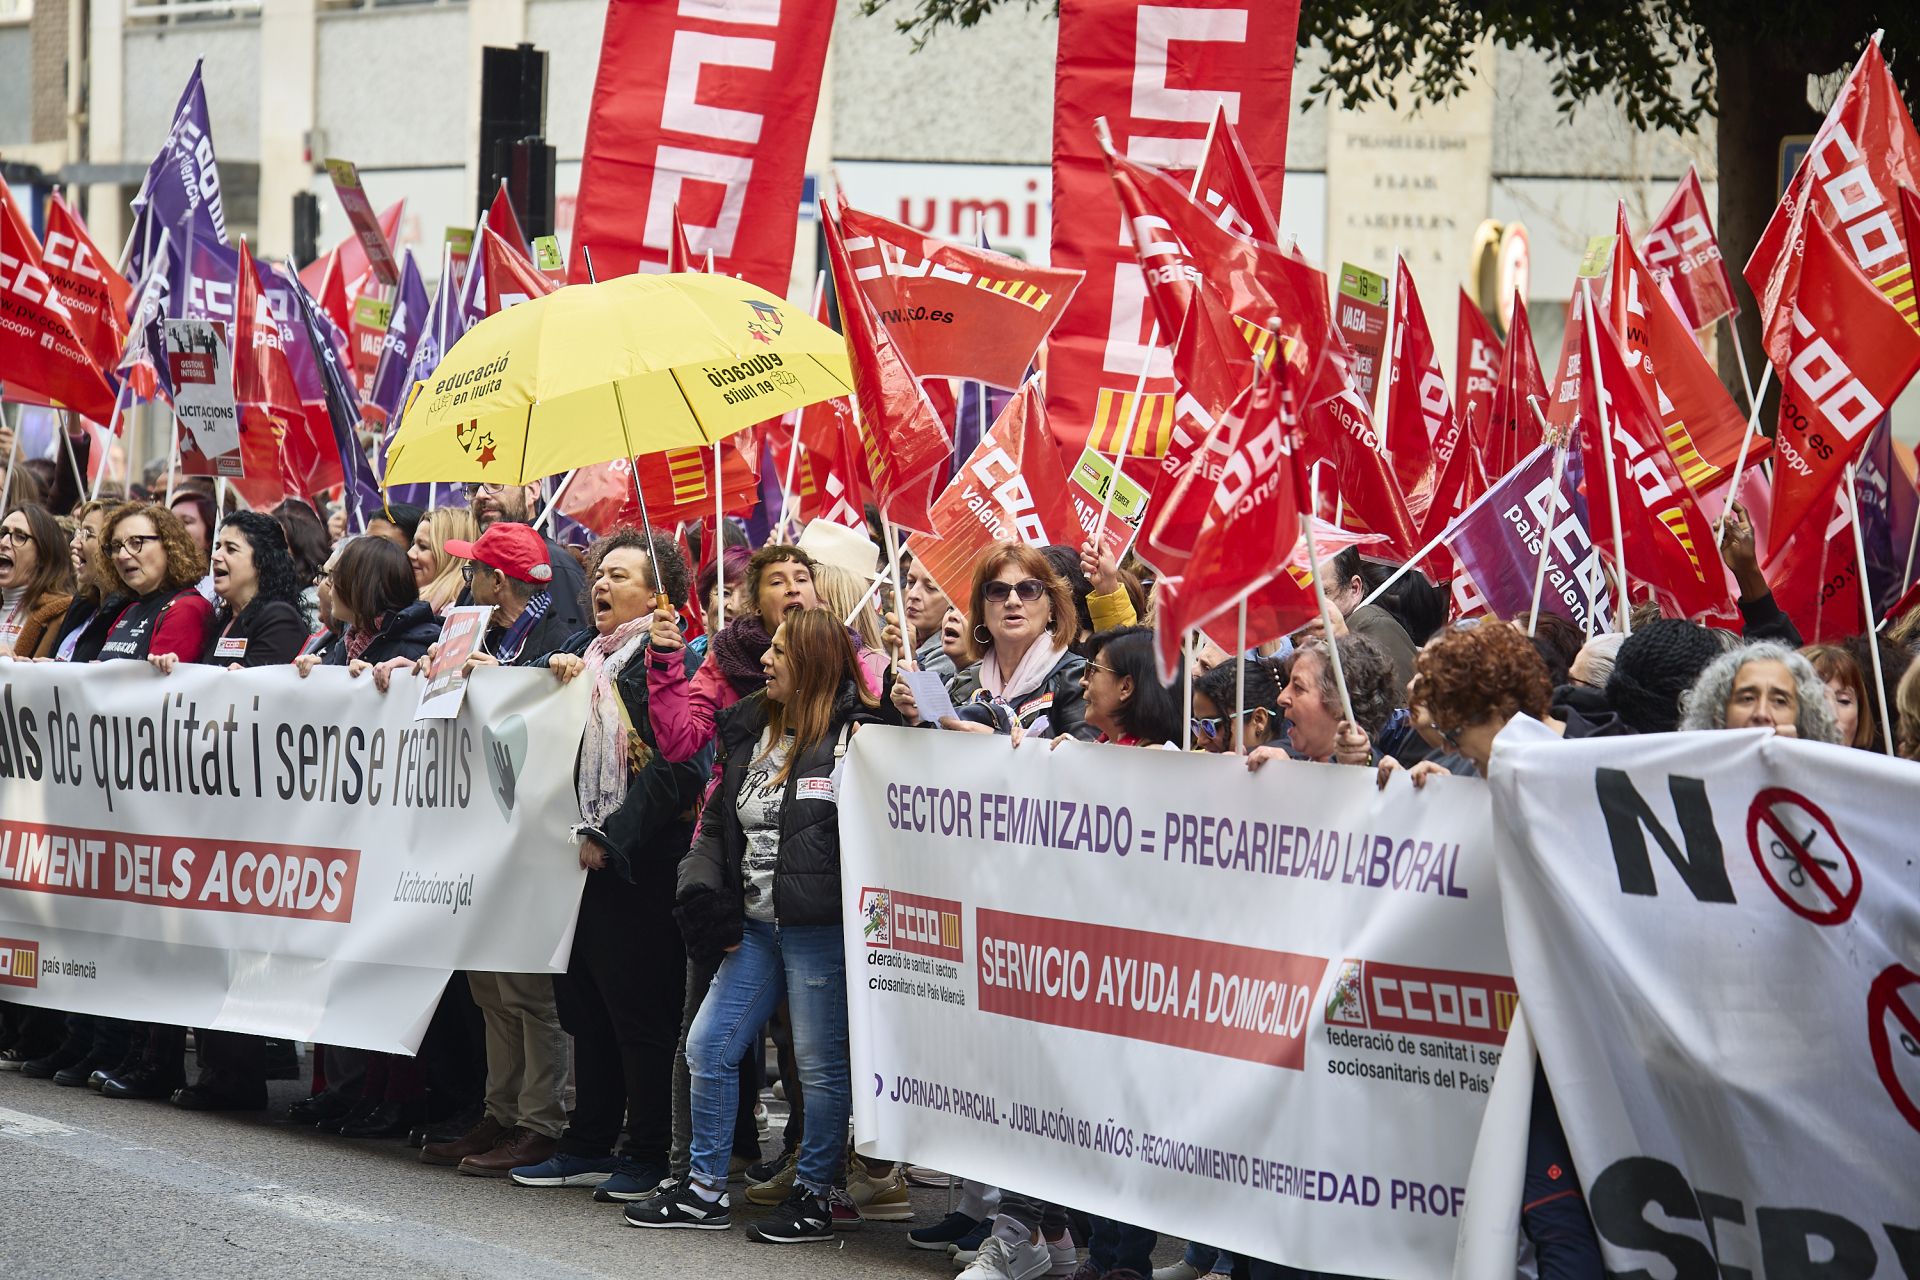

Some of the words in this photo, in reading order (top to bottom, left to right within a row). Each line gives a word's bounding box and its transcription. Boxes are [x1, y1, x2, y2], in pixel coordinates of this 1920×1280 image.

[1342, 304, 1367, 333] VAGA
[435, 350, 510, 395] educació
[453, 391, 468, 406] en
[470, 378, 502, 401] lluita
[179, 405, 234, 419] LICITACIONS
[203, 420, 216, 432] JA!
[47, 685, 83, 787] de
[90, 692, 241, 813] qualitat
[252, 695, 263, 798] i
[275, 722, 386, 805] sense
[392, 719, 472, 809] retalls
[887, 782, 973, 838] SECTOR
[980, 792, 1133, 857] FEMINIZADO
[1140, 828, 1156, 853] =
[1163, 811, 1339, 882] PRECARIEDAD
[1341, 832, 1469, 900] LABORAL
[114, 842, 195, 900] DELS
[198, 850, 349, 913] ACORDS
[393, 870, 453, 906] Licitacions
[452, 872, 474, 915] ja!
[894, 903, 941, 946] CCOO
[42, 956, 60, 977] país
[62, 959, 97, 980] valencià
[902, 953, 911, 970] de
[911, 957, 931, 974] sanitat
[935, 963, 958, 980] sectors
[916, 982, 926, 998] del
[927, 982, 940, 1001] País
[939, 985, 965, 1006] Valencià
[980, 935, 1090, 1002] SERVICIO
[1095, 953, 1179, 1018] AYUDA
[1182, 968, 1200, 1021] A
[1204, 972, 1310, 1041] DOMICILIO
[1371, 976, 1491, 1030] CCOO
[1326, 1026, 1394, 1052] federació
[1397, 1032, 1416, 1055] de
[1419, 1042, 1467, 1062] sanitat
[1470, 1044, 1476, 1063] i
[1327, 1058, 1431, 1086] sociosanitaris
[1434, 1068, 1456, 1089] del
[1459, 1071, 1489, 1094] País
[890, 1076, 951, 1113] JORNADA
[952, 1088, 999, 1126] PARCIAL
[1009, 1107, 1075, 1146] JUBILACIÓN
[1077, 1120, 1092, 1149] 60
[1093, 1118, 1133, 1158] AÑOS
[1140, 1132, 1249, 1186] RECONOCIMIENTO
[1251, 1158, 1380, 1208] ENFERMEDAD
